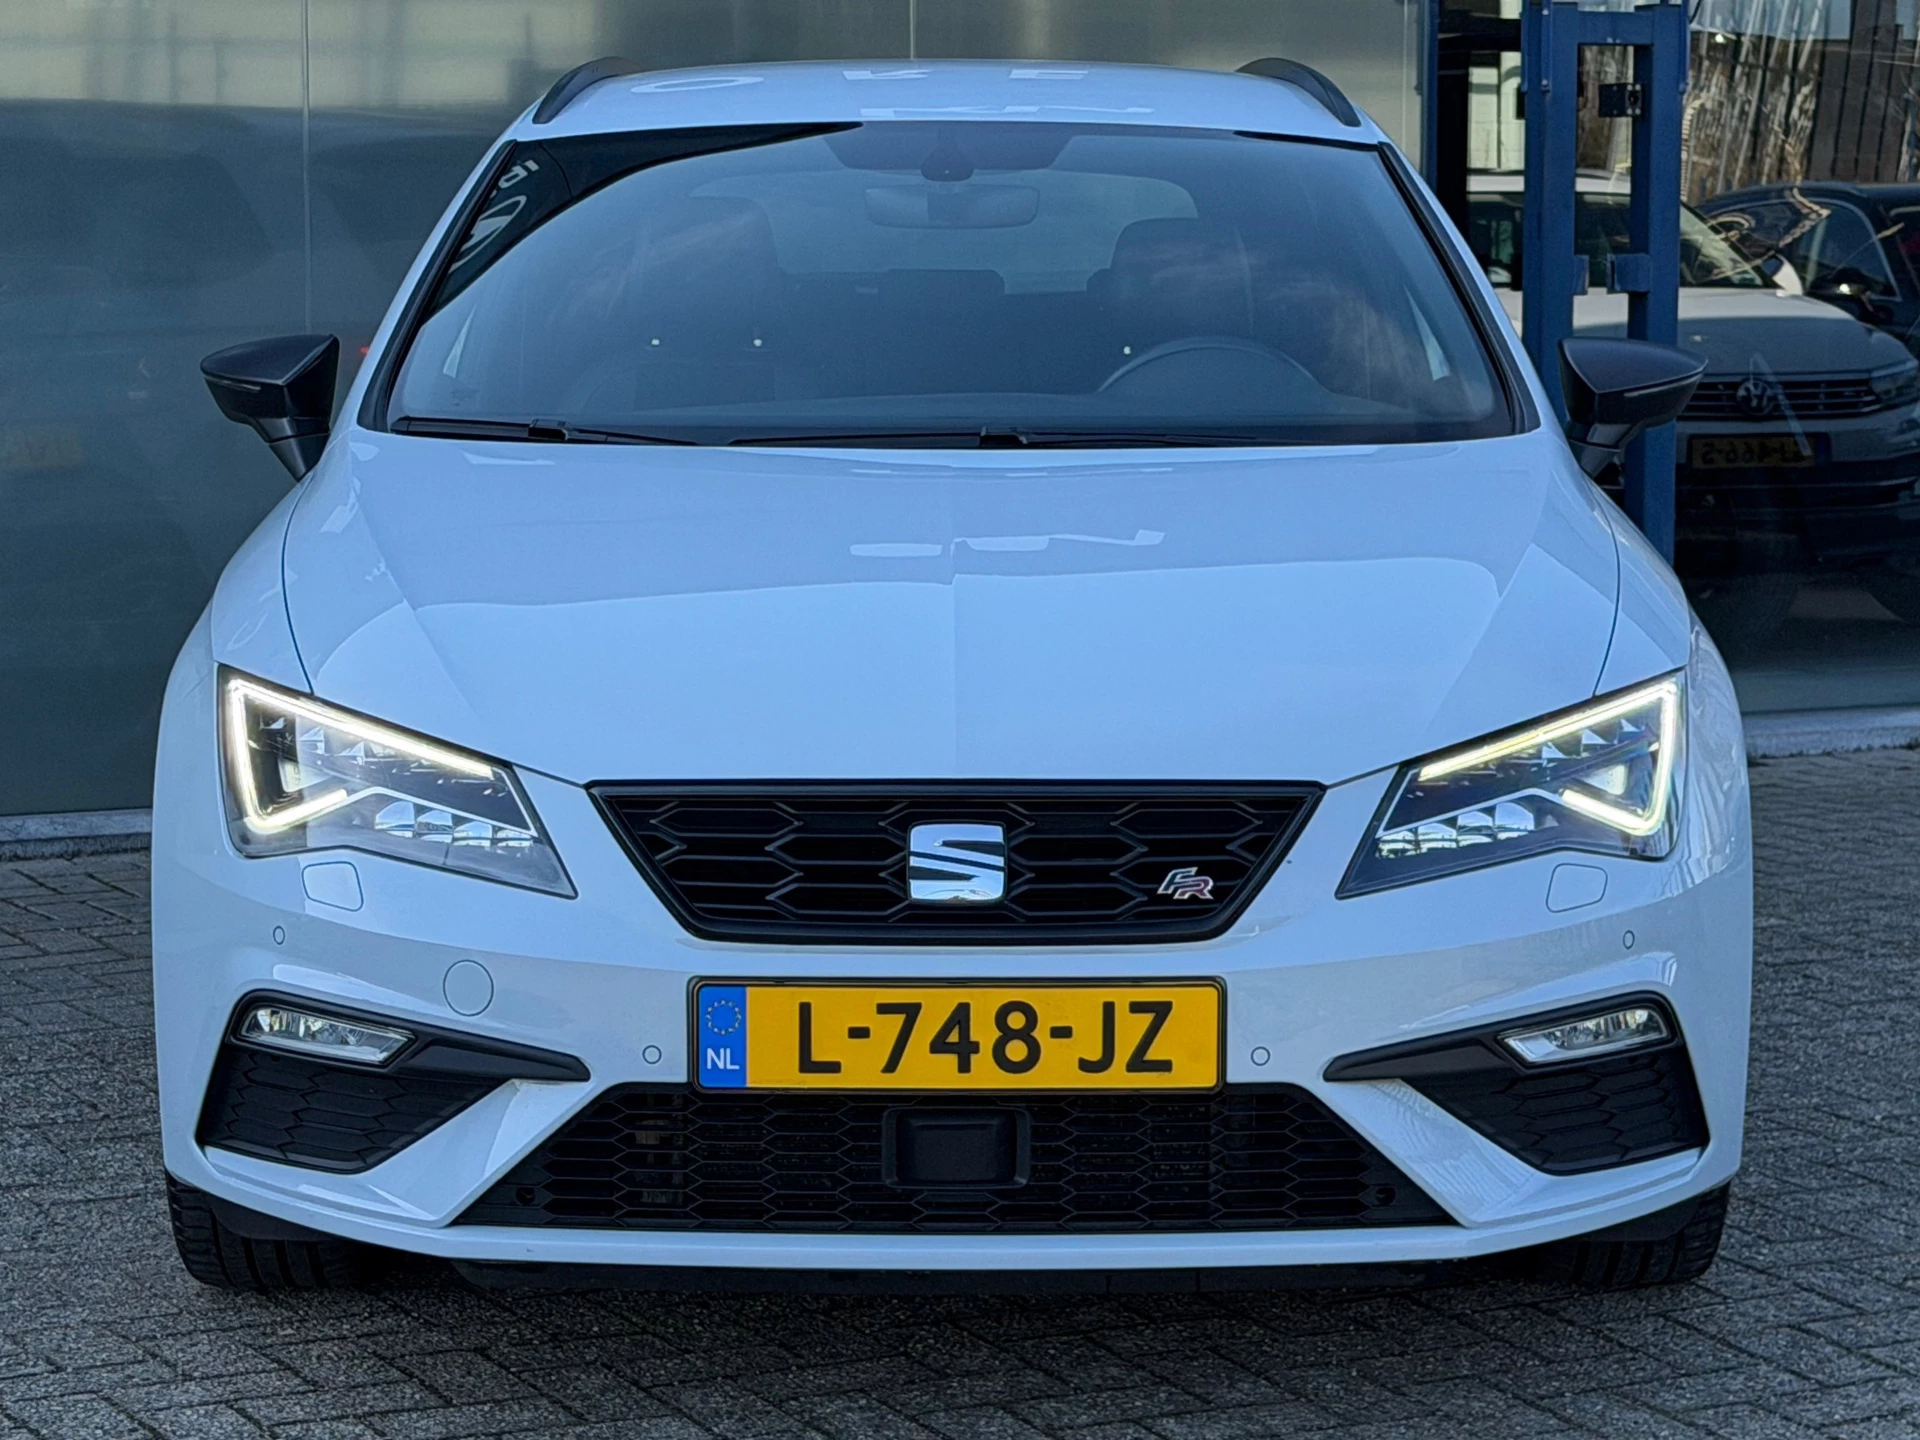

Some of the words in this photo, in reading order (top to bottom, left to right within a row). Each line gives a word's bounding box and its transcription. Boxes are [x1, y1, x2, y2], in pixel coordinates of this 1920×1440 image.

[1157, 867, 1214, 899] FR
[799, 1000, 1173, 1074] L-748-JZ
[706, 1047, 740, 1070] NL
